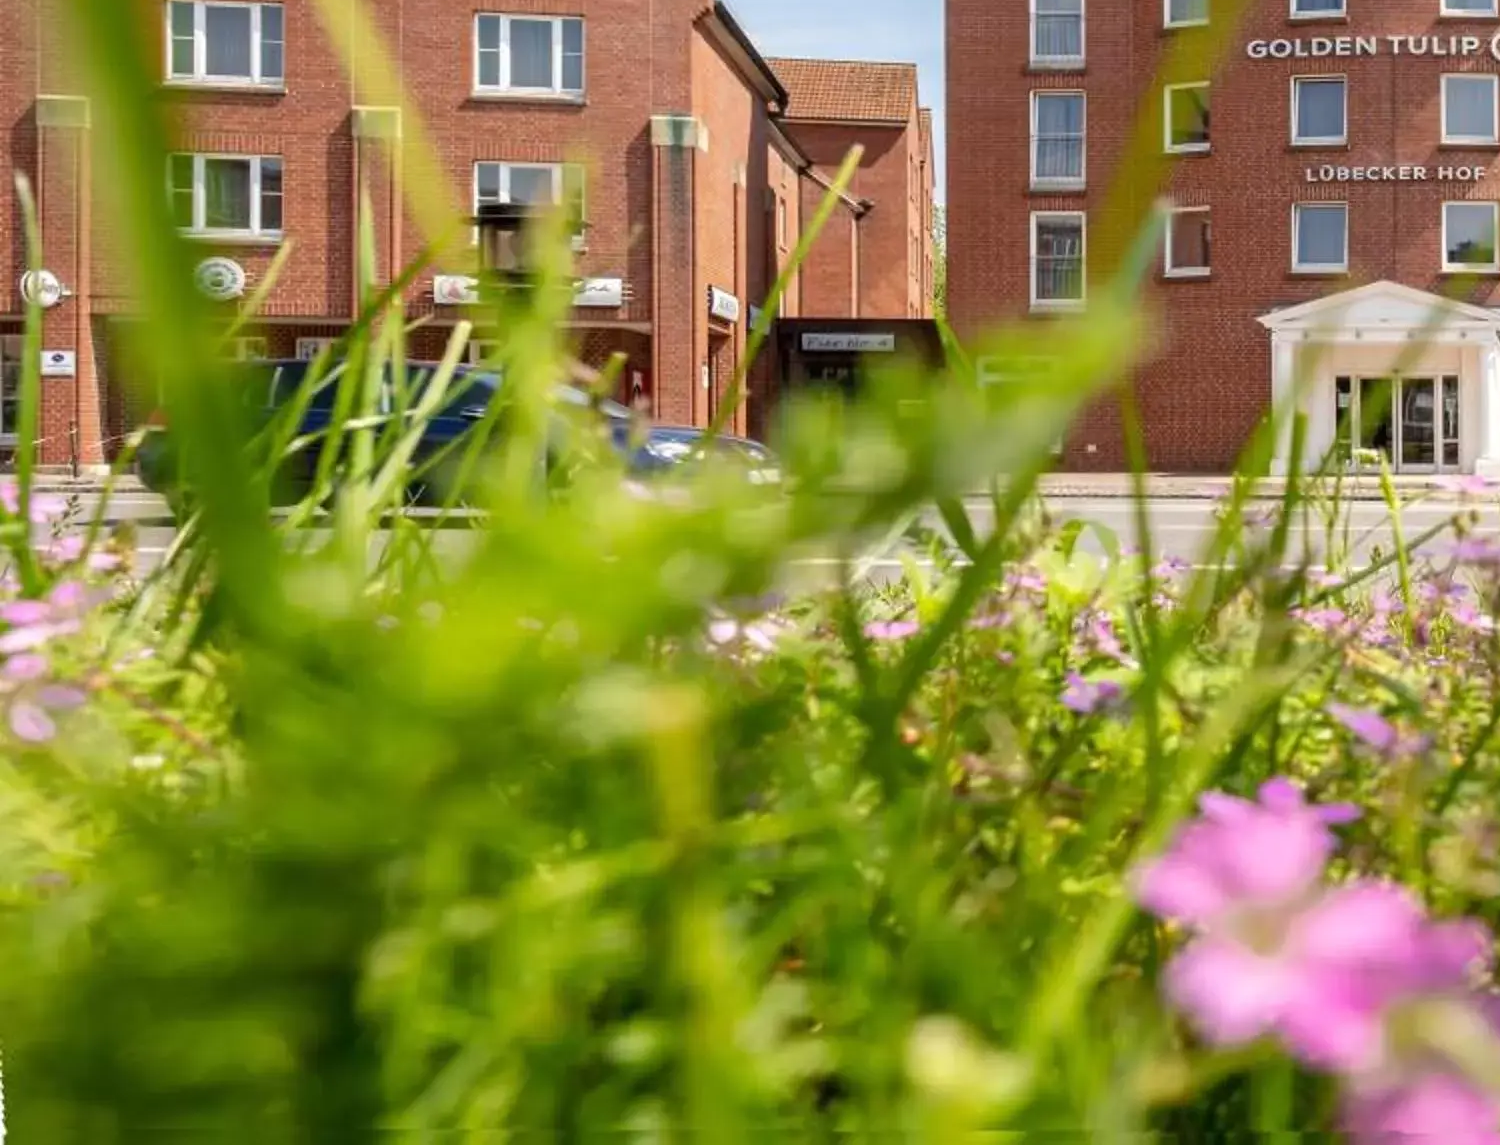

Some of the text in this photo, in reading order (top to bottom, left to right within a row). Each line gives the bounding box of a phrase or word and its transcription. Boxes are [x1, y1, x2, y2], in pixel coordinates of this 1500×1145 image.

[1247, 35, 1480, 58] GOLDEN TULIP
[1306, 164, 1487, 182] LÜBECKER HOF
